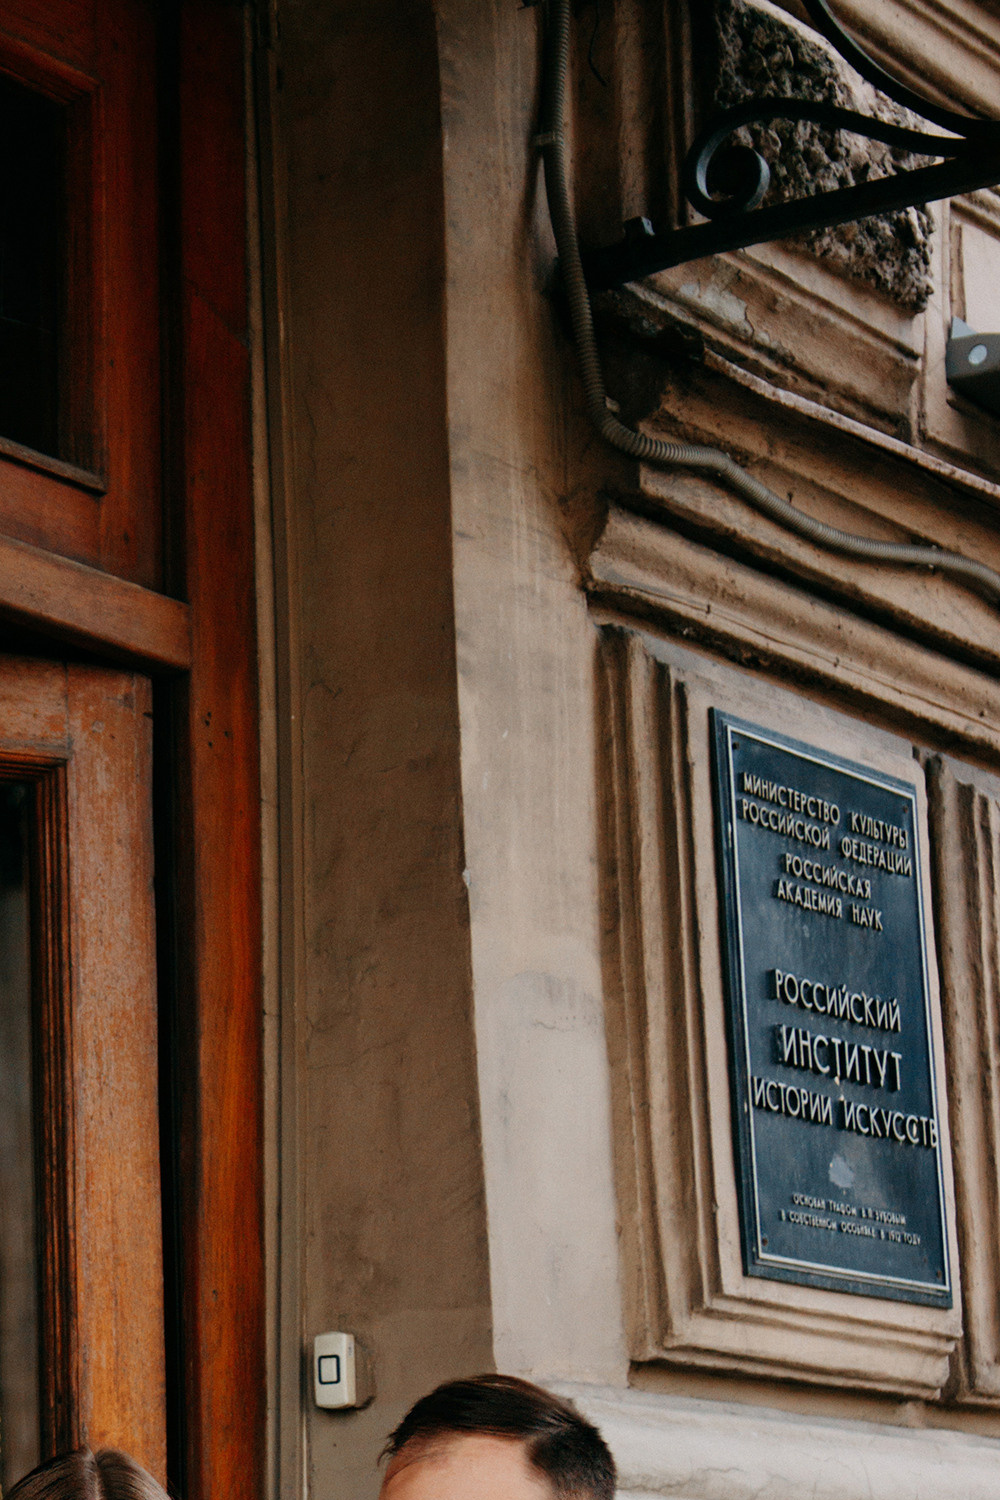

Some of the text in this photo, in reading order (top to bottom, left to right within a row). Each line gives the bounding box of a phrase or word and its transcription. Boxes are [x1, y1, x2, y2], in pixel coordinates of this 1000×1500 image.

[742, 798, 913, 877] РОССИЙСКОЙ ФЕДЕРАЦИИ
[743, 771, 909, 849] МИНИСТЕРСТВО КУЛЬТУРЫ
[777, 879, 884, 931] АКАДЕМИЯ НАУК
[785, 853, 871, 899] РОССИЙСКАЯ
[775, 968, 902, 1032] РОССИЙСКИЙ
[782, 1024, 903, 1091] ИНСТИТУТ
[753, 1076, 938, 1148] ИСТОРИИ ИСКУССТВ
